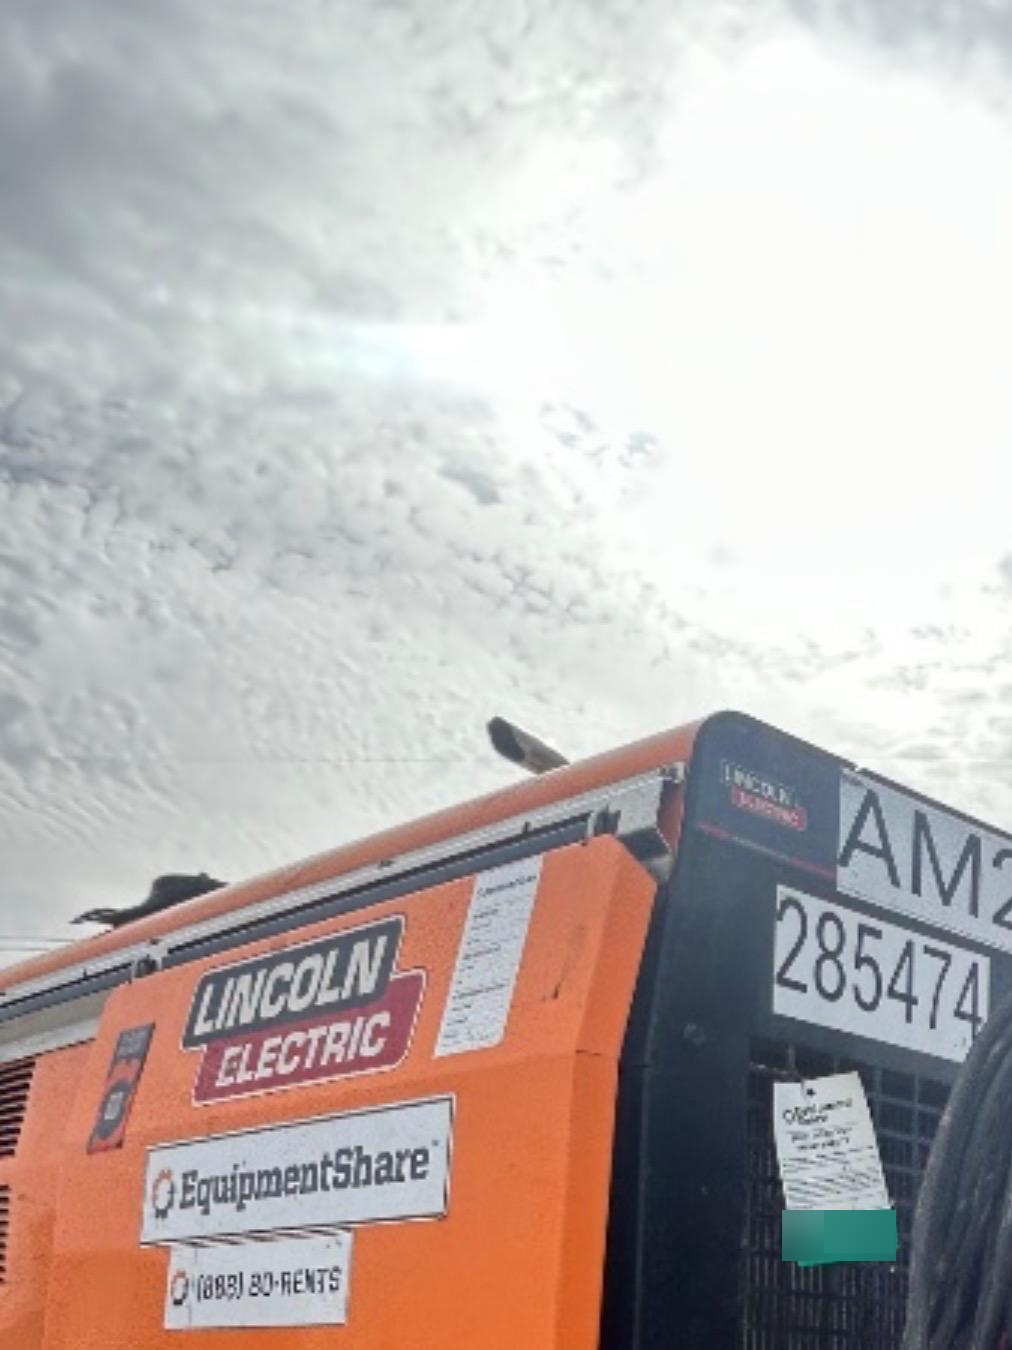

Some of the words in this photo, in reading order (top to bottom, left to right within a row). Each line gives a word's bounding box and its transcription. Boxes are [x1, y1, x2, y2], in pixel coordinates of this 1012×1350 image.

[194, 934, 388, 1036] LINCOLN
[775, 896, 984, 1043] 285474
[215, 1011, 391, 1087] ELECTRIC
[178, 1145, 430, 1216] EquipmentShare
